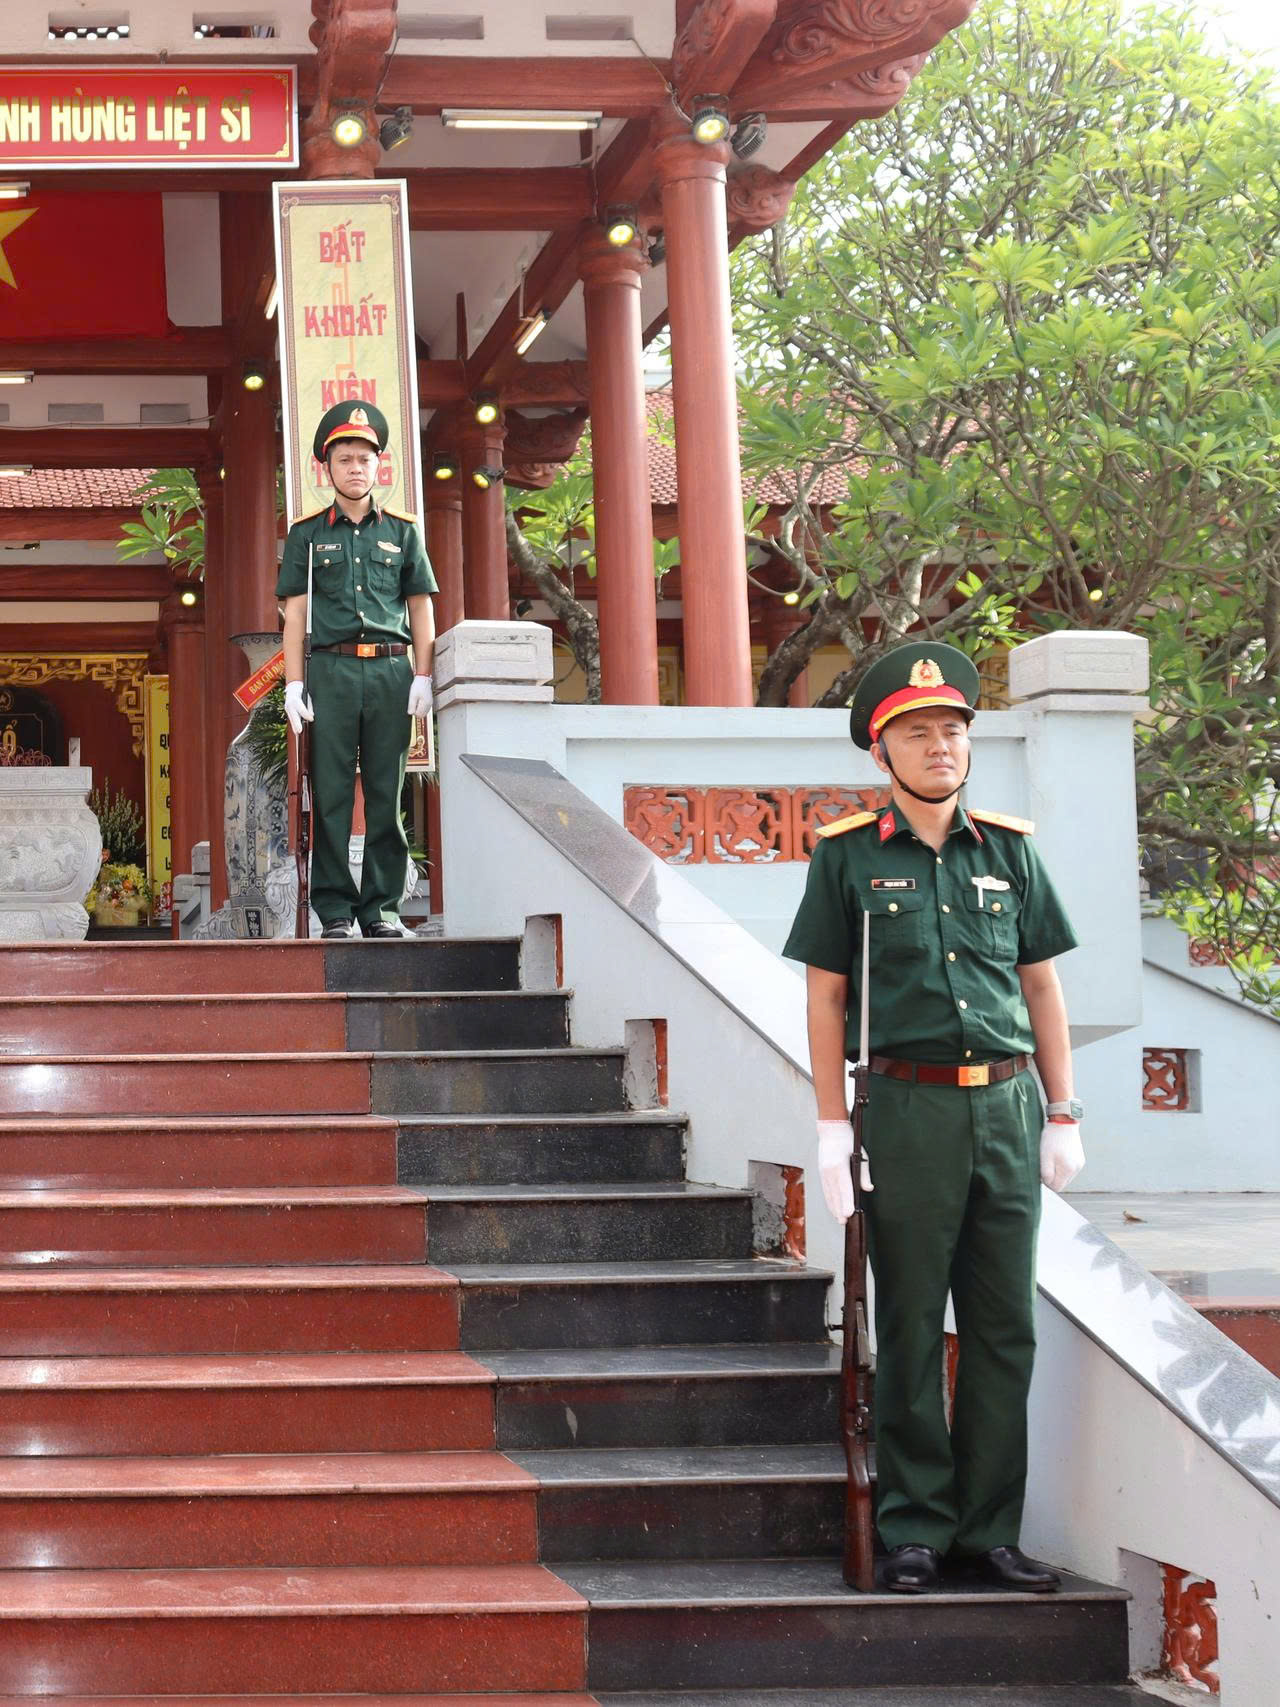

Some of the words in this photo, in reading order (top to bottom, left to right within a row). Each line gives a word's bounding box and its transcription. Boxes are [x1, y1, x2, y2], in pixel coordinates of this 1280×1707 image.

[51, 87, 136, 143] HÙNG
[146, 86, 211, 150] LIỆT
[220, 89, 251, 143] SĨ
[320, 219, 366, 263] BẤT
[304, 293, 387, 337] KHUẤT
